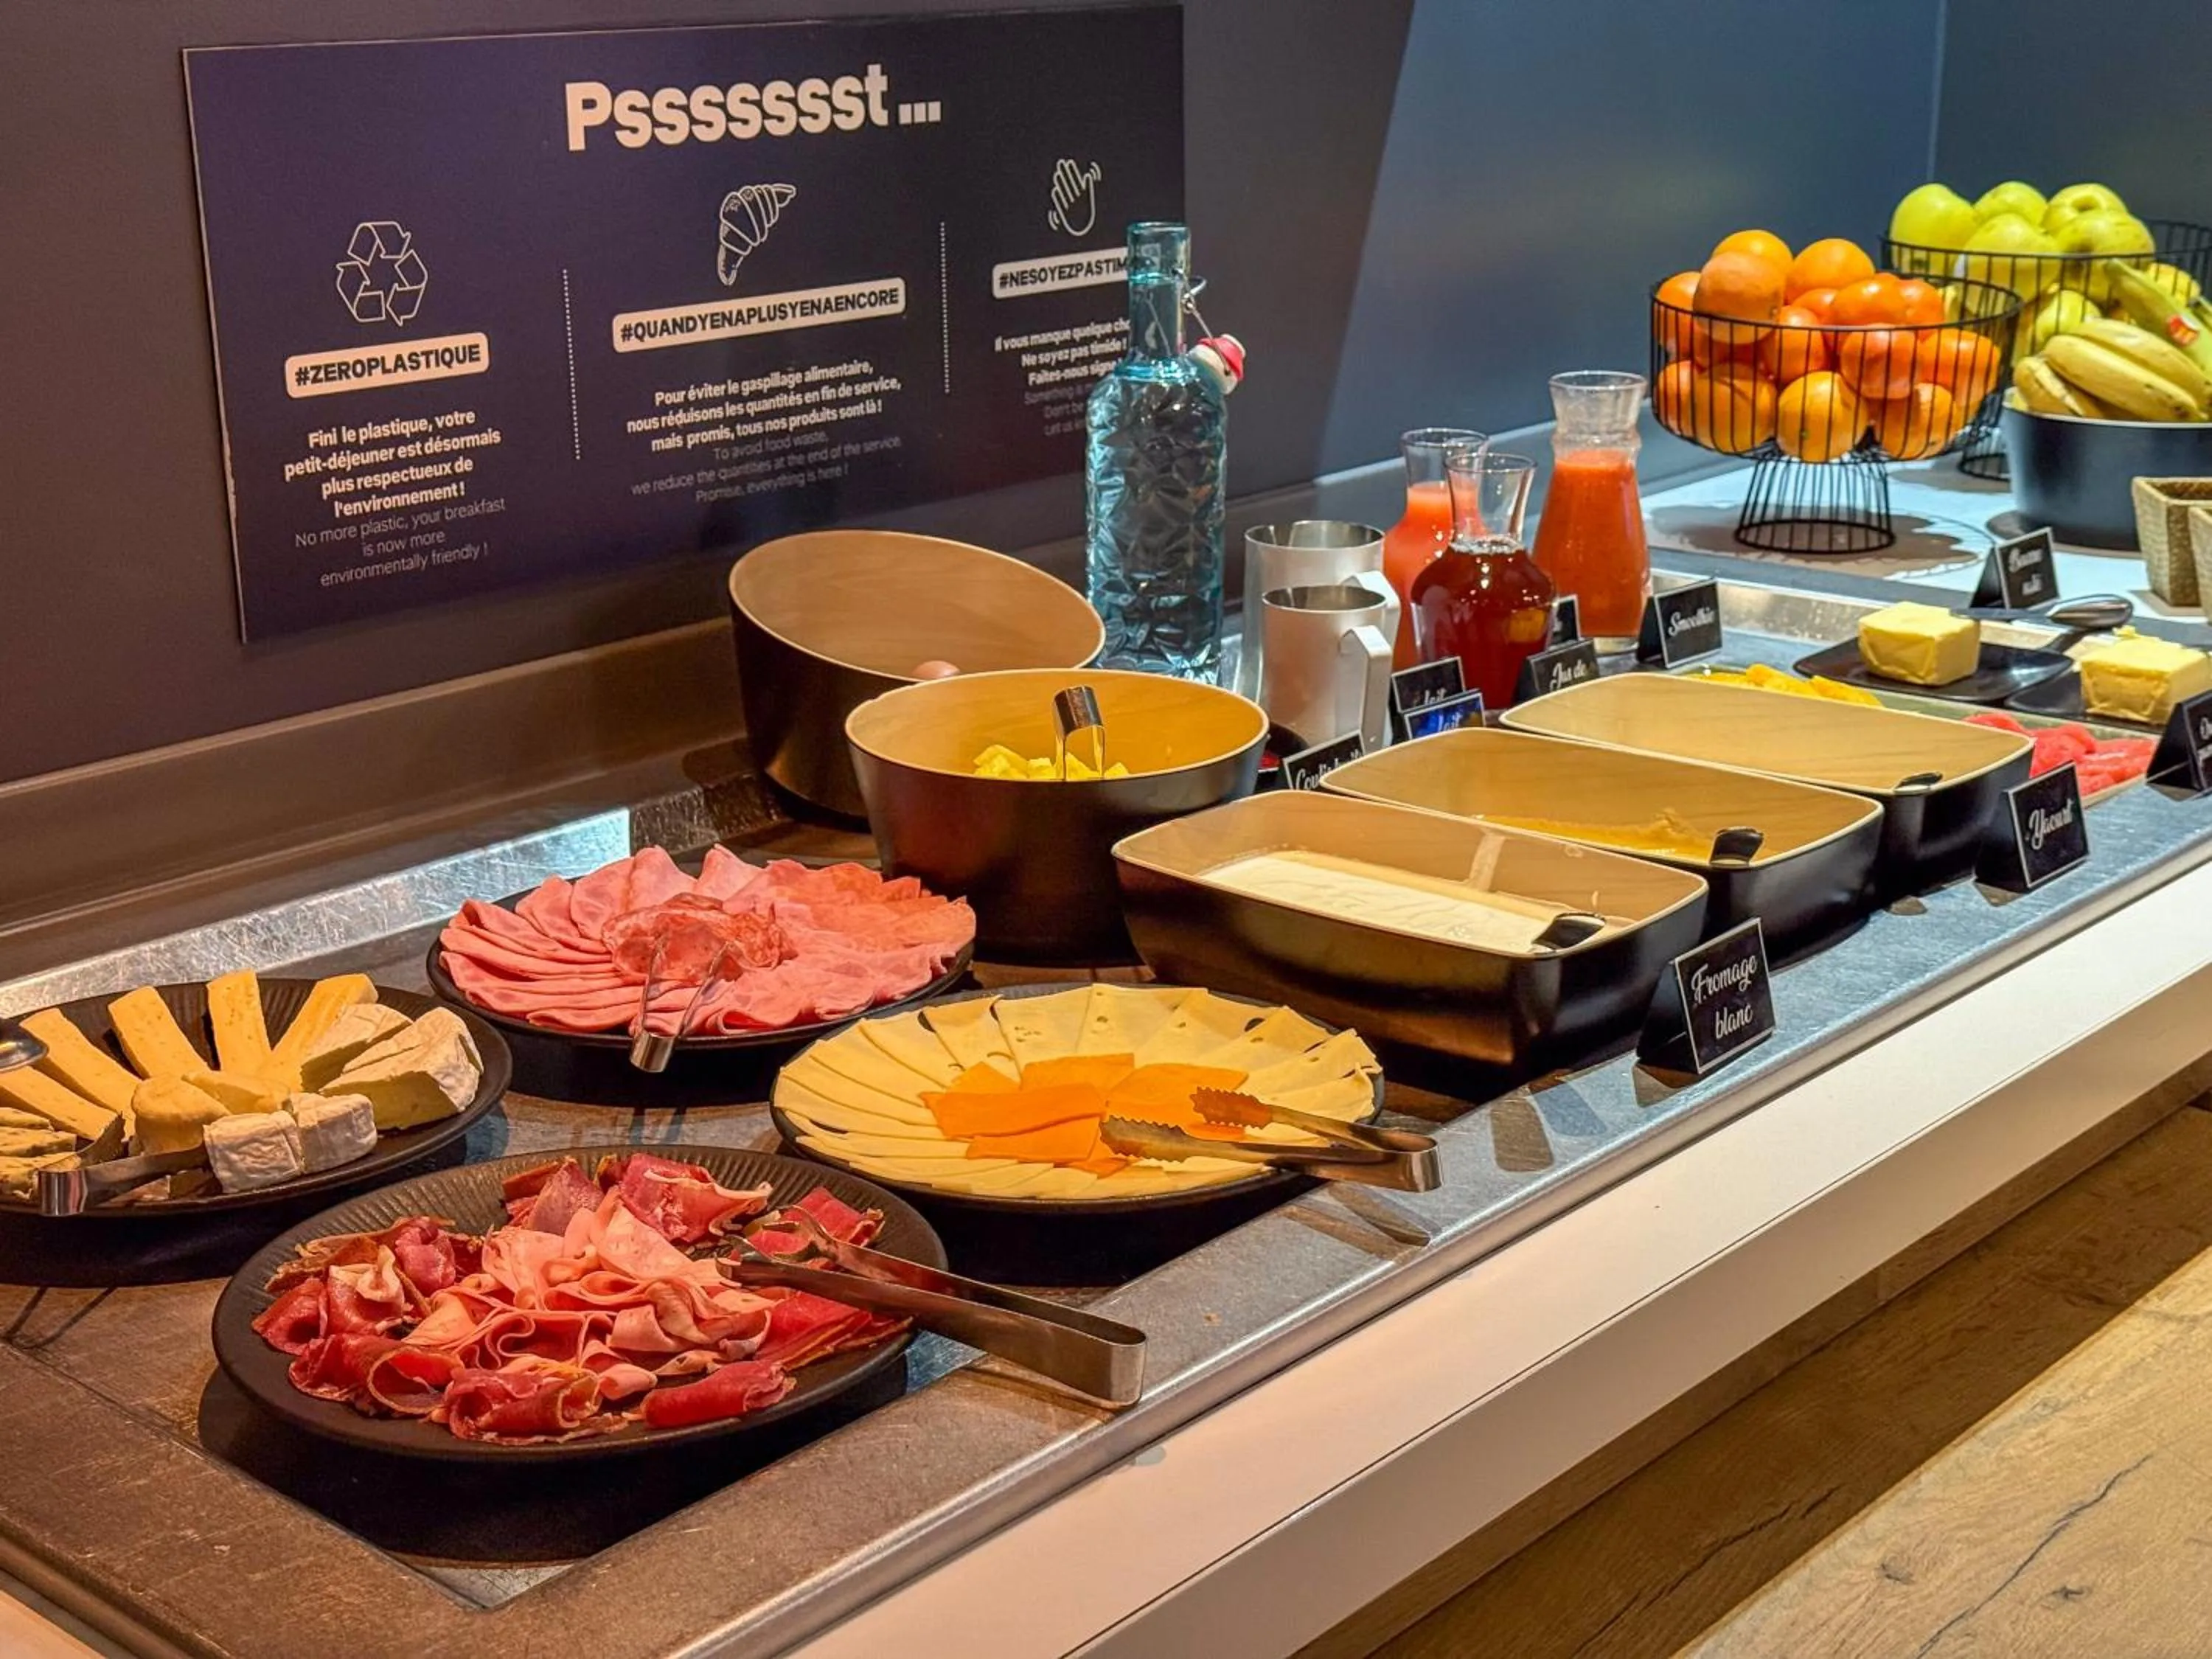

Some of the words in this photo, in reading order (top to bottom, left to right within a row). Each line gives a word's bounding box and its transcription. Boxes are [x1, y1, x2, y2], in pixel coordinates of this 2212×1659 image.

[620, 288, 900, 343] #QUANDYENAPLUSYENAENCORE
[995, 336, 1003, 352] Il
[1003, 335, 1029, 349] vous
[1030, 329, 1071, 348] manque
[1073, 321, 1112, 341] quelque
[295, 344, 481, 386] #ZEROPLASTIQUE
[1022, 352, 1037, 367] Ne
[1038, 347, 1069, 366] soyez
[1071, 344, 1089, 363] pas
[1091, 338, 1121, 356] timide
[655, 389, 686, 406] Pour
[688, 383, 726, 402] éviter
[728, 378, 740, 395] le
[741, 370, 802, 397] gaspillage
[804, 359, 874, 383] alimentaire,
[1029, 365, 1089, 386] Faites-nous
[627, 417, 659, 434] nous
[661, 406, 725, 429] réduisons
[726, 401, 744, 418] les
[746, 390, 803, 418] quantités
[804, 389, 819, 405] en
[821, 384, 837, 402] fin
[838, 383, 853, 397] de
[855, 375, 902, 397] service,
[308, 427, 338, 448] Fini
[342, 425, 358, 443] le
[359, 417, 433, 445] plastique,
[435, 410, 476, 428] votre
[652, 432, 684, 452] mais
[686, 426, 735, 449] promis,
[737, 417, 763, 437] tous
[765, 414, 787, 432] nos
[789, 407, 838, 432] produits
[839, 403, 864, 423] sont
[714, 448, 728, 461] To
[731, 440, 762, 459] avoid
[765, 436, 792, 454] food
[285, 445, 394, 481] petit-déjeuner
[397, 442, 422, 459] est
[425, 428, 501, 453] désormais
[631, 481, 650, 495] we
[653, 474, 695, 493] reduce
[697, 470, 716, 484] the
[787, 451, 805, 467] the
[807, 447, 828, 463] end
[830, 444, 843, 459] of
[844, 441, 861, 456] the
[321, 476, 355, 500] plus
[357, 461, 451, 490] respectueux
[454, 456, 473, 472] de
[296, 533, 316, 549] No
[320, 526, 358, 543] more
[361, 514, 408, 544] plastic,
[411, 509, 442, 530] your
[445, 497, 506, 521] breakfast
[362, 542, 374, 557] is
[377, 537, 406, 553] now
[410, 529, 445, 549] more
[320, 553, 428, 587] environmentally
[431, 545, 480, 566] friendly
[1691, 956, 1757, 1004] Fromage
[1714, 1003, 1753, 1040] blanc
